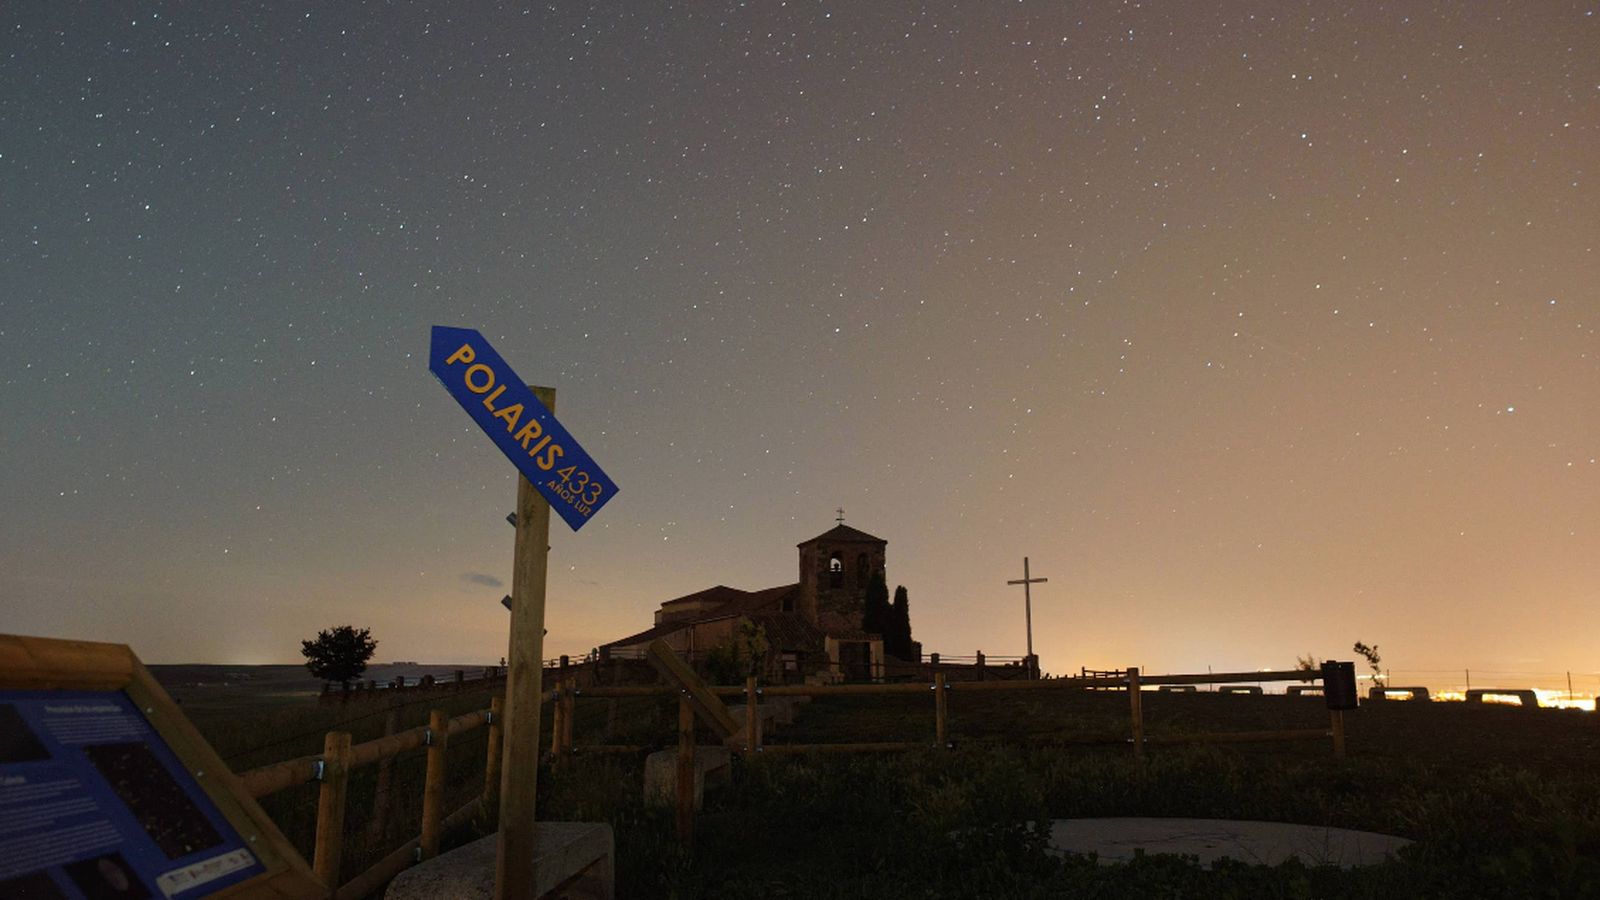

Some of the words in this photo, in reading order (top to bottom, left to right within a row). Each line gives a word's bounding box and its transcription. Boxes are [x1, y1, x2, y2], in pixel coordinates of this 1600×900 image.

[446, 344, 565, 471] POLARIS
[557, 465, 602, 506] 433
[547, 479, 575, 504] AÑOS
[574, 499, 592, 517] LUZ
